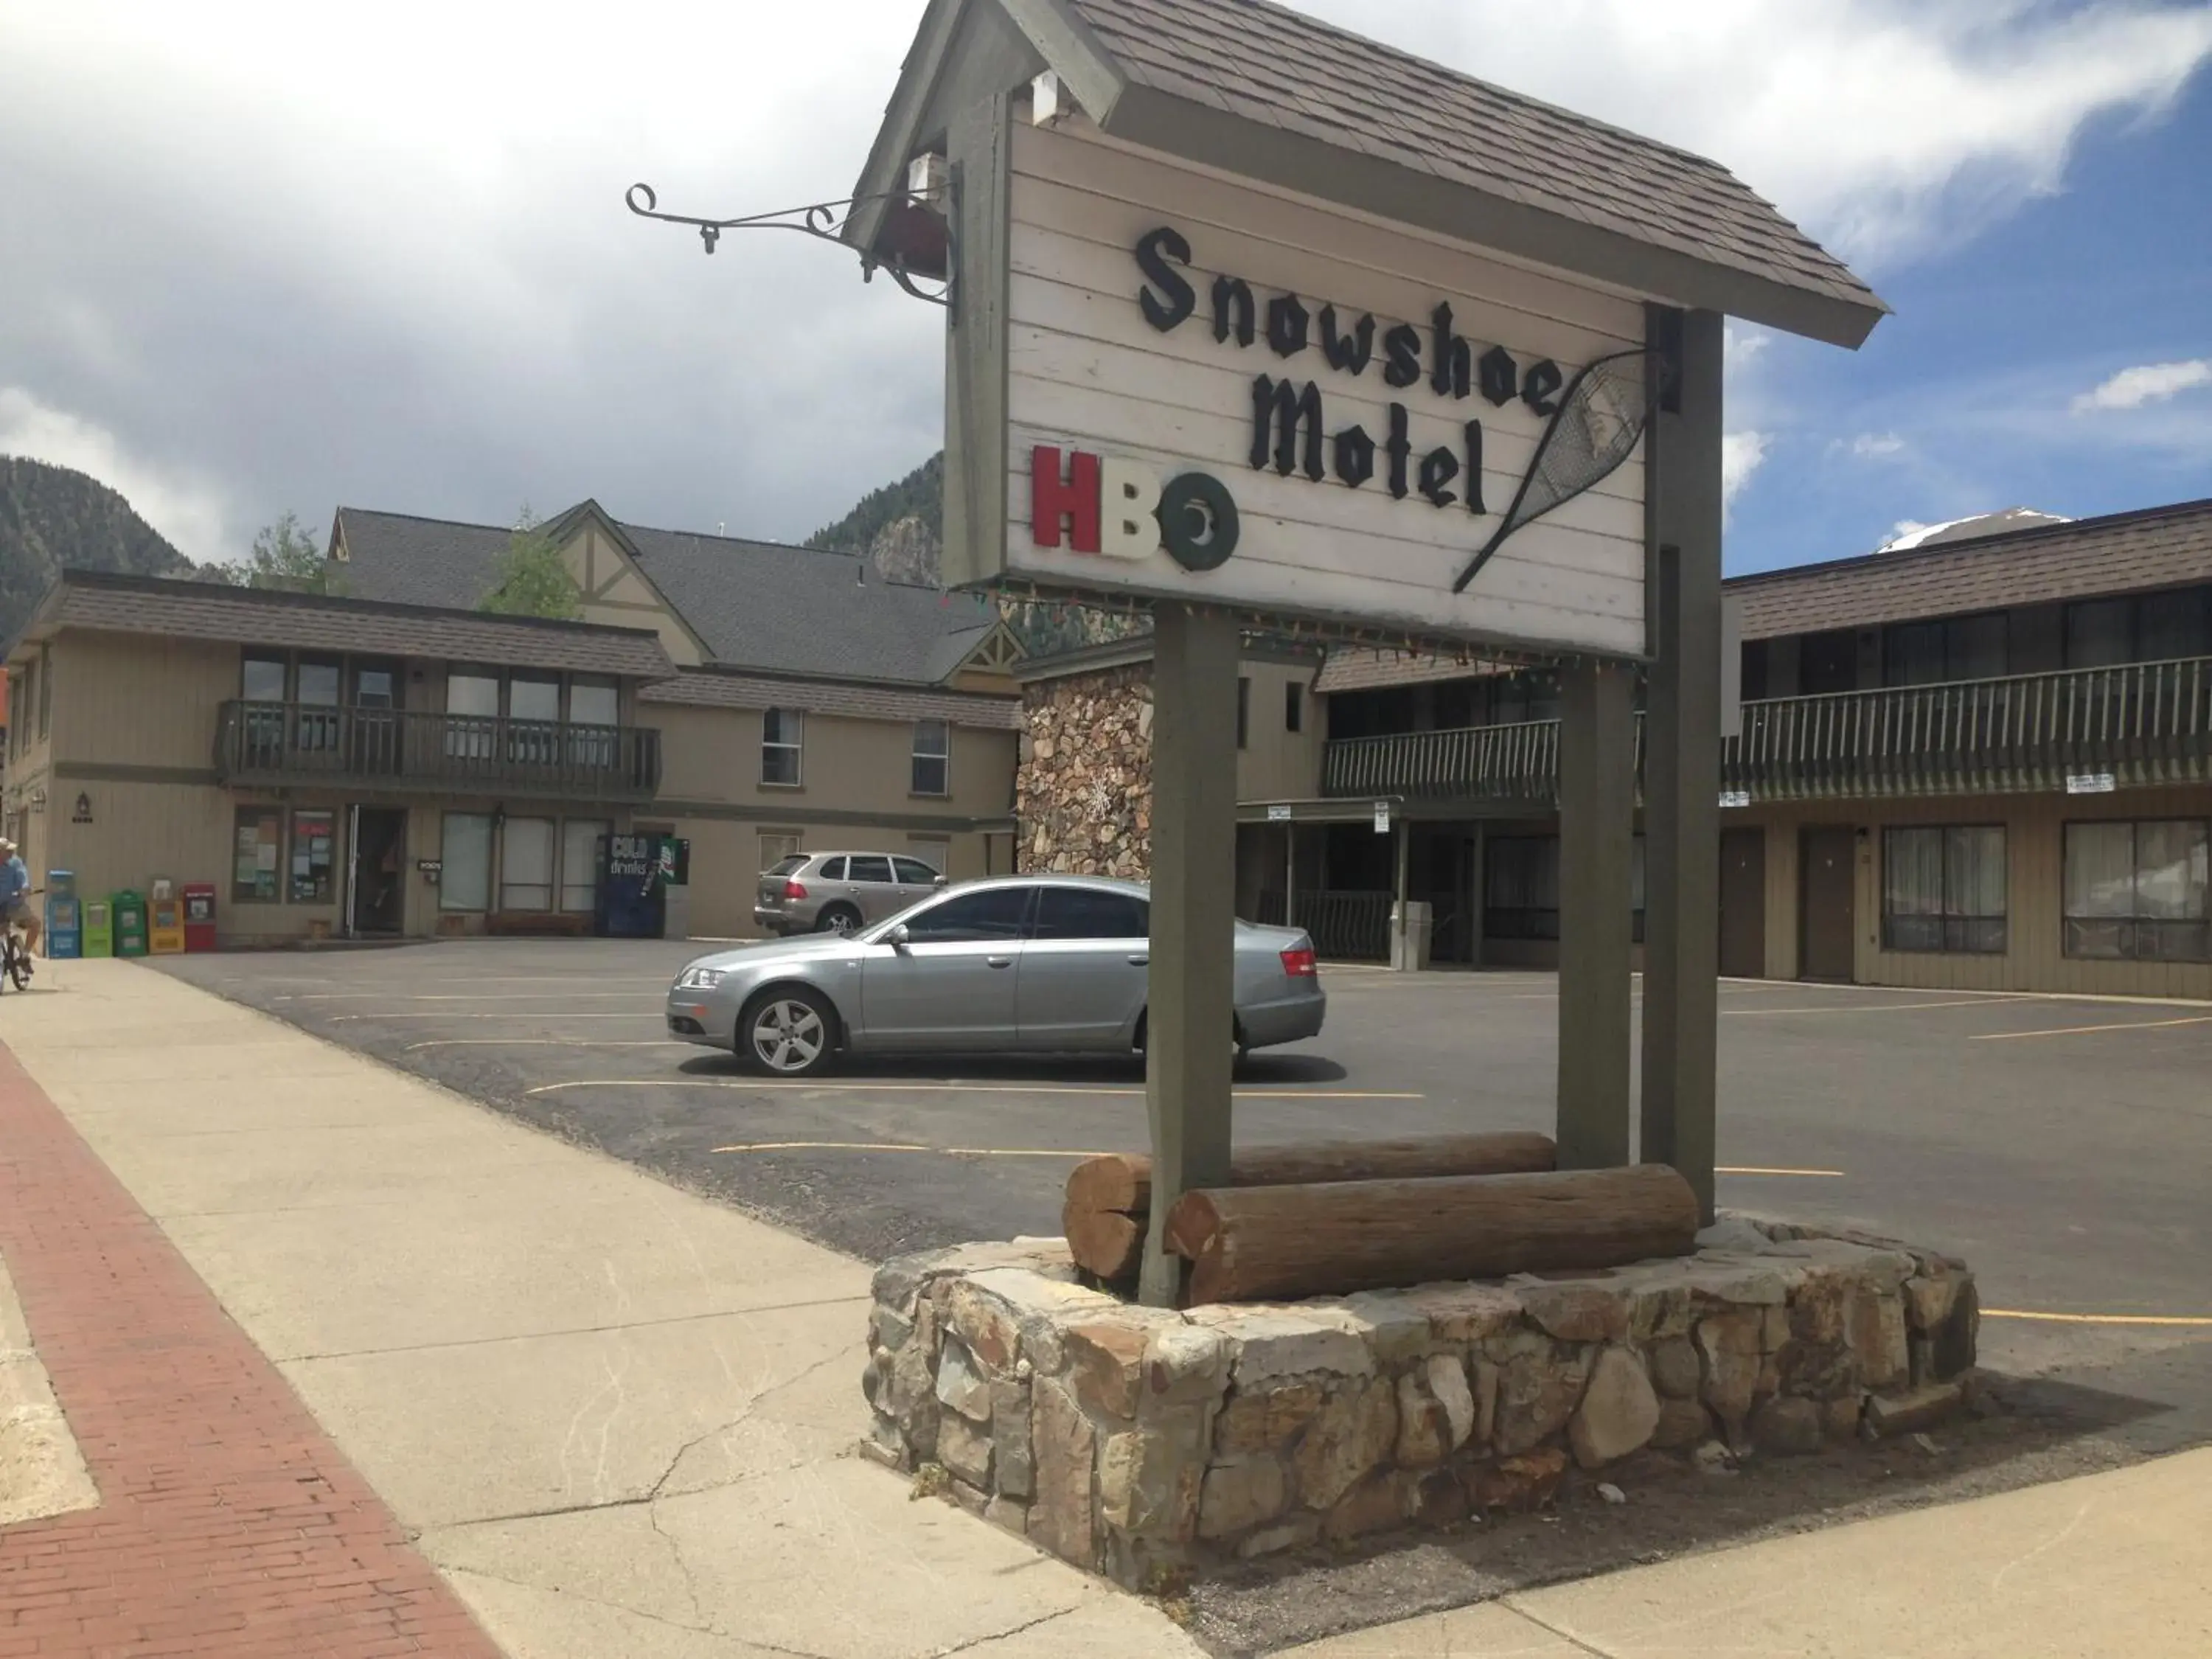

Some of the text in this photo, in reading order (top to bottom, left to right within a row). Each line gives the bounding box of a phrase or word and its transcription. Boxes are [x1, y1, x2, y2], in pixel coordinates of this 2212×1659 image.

[1135, 226, 1562, 417] Snowshoe
[1032, 445, 1240, 572] HBO
[1249, 372, 1487, 515] Motel
[611, 836, 647, 859] COLD
